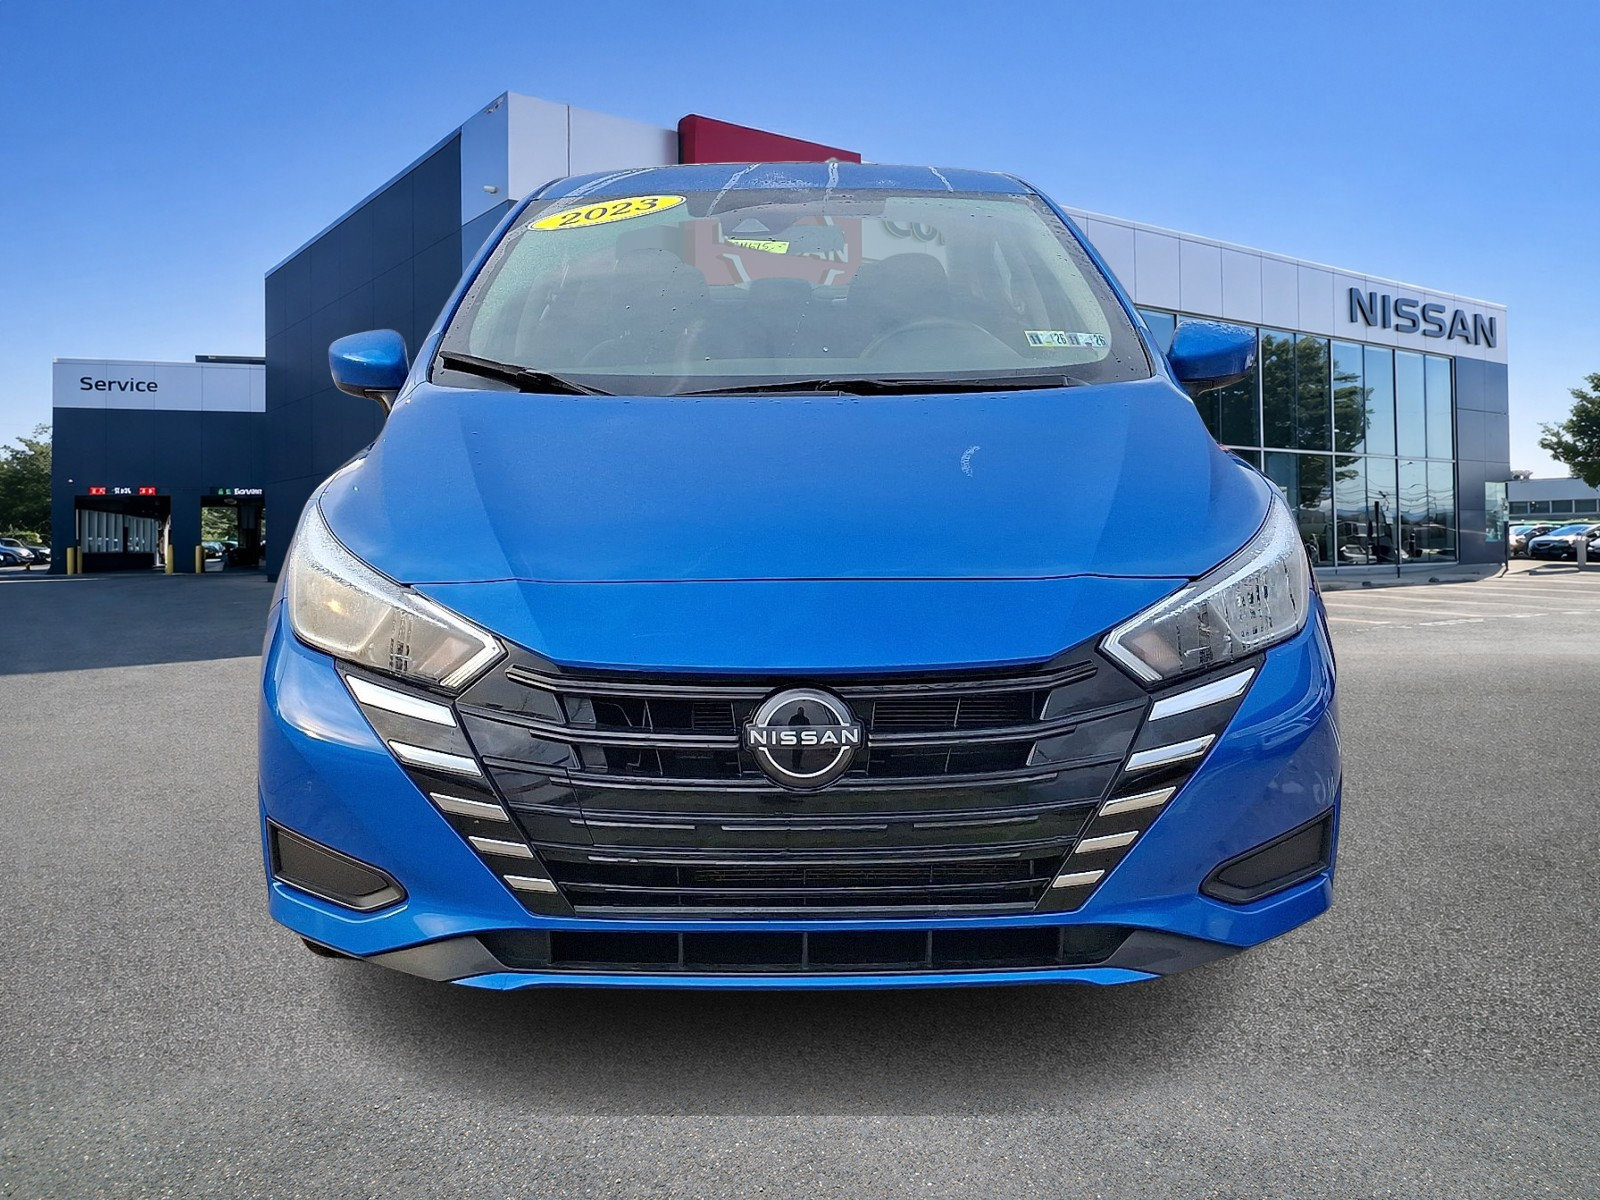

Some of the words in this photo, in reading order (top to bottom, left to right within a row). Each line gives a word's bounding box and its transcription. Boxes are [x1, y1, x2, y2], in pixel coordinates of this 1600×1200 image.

[558, 198, 659, 227] 2023
[1348, 287, 1498, 348] NISSAN
[80, 376, 158, 393] Service
[750, 728, 859, 746] NISSAN
